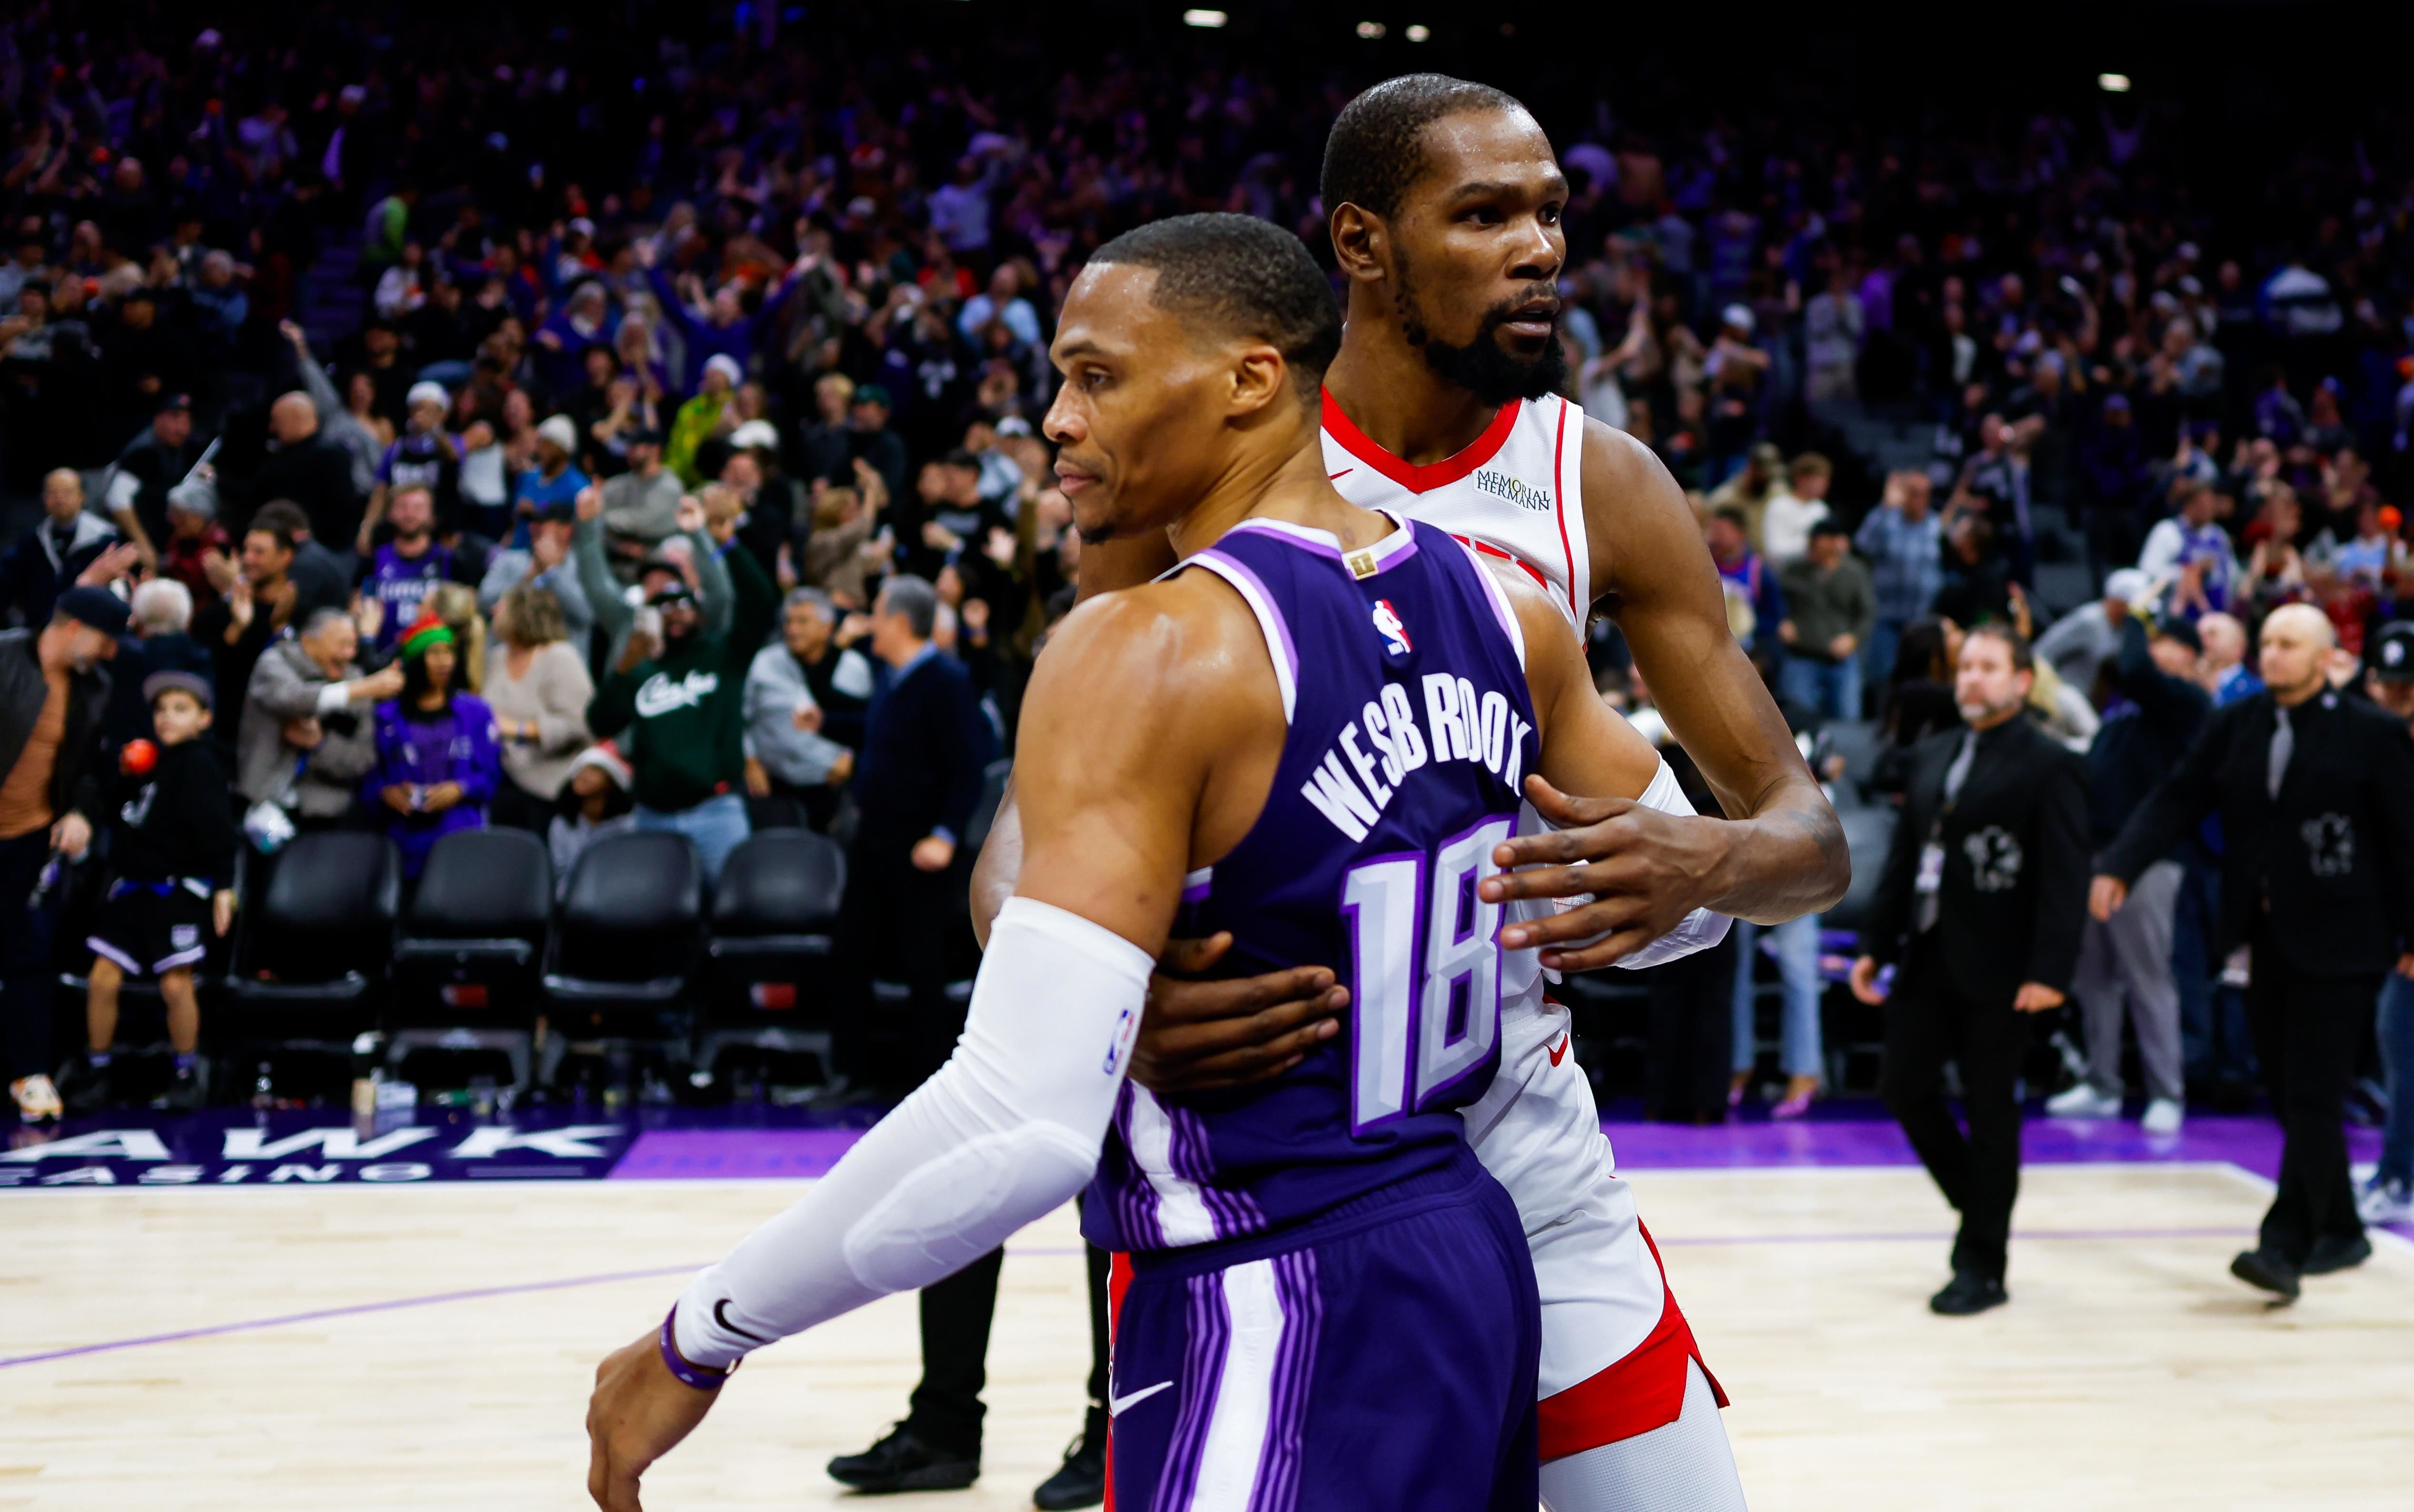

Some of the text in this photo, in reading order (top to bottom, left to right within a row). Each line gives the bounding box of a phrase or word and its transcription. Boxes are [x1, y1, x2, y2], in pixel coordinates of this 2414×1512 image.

[1477, 478, 1549, 511] HERMANN
[1478, 470, 1550, 501] MEMORIAL
[1301, 672, 1532, 843] WESBROOK
[1340, 813, 1518, 1137] 18
[0, 1127, 626, 1160] AWK
